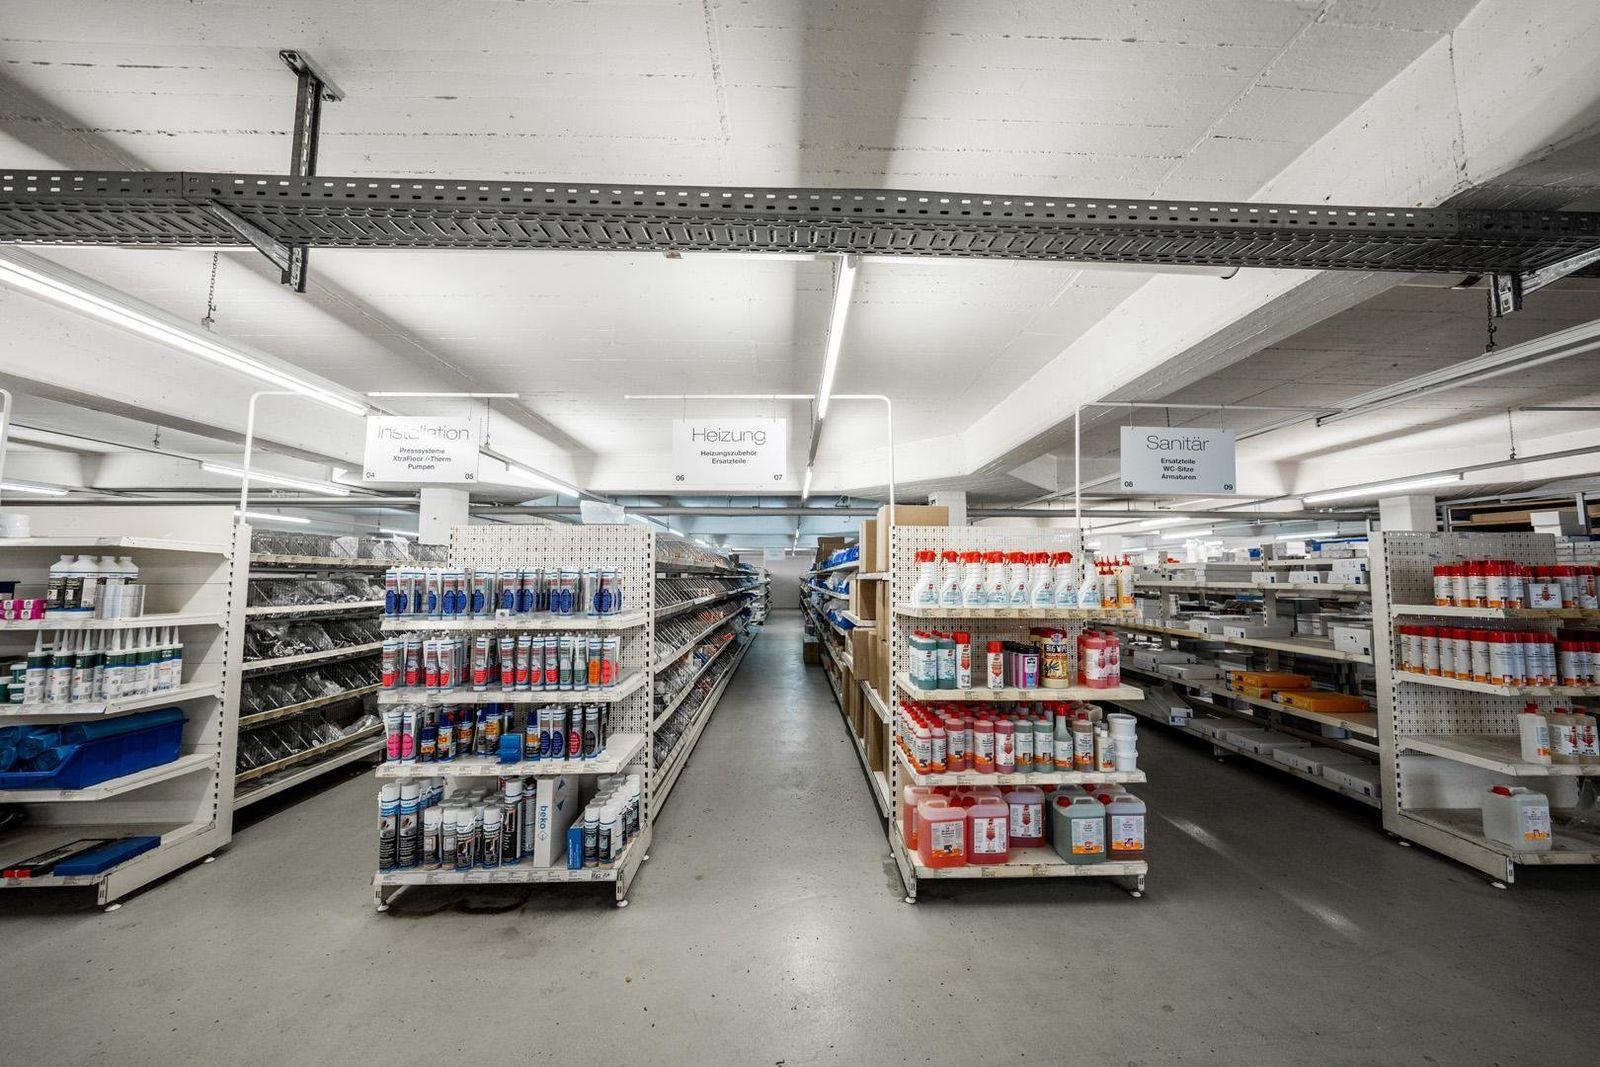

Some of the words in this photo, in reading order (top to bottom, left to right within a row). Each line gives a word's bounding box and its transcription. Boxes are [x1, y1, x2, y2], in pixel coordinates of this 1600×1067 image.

[692, 427, 766, 446] Heizung
[1146, 435, 1210, 452] Sanitär
[399, 447, 446, 455] Presssysteme
[407, 463, 435, 471] Pumpen
[539, 805, 549, 830] beko
